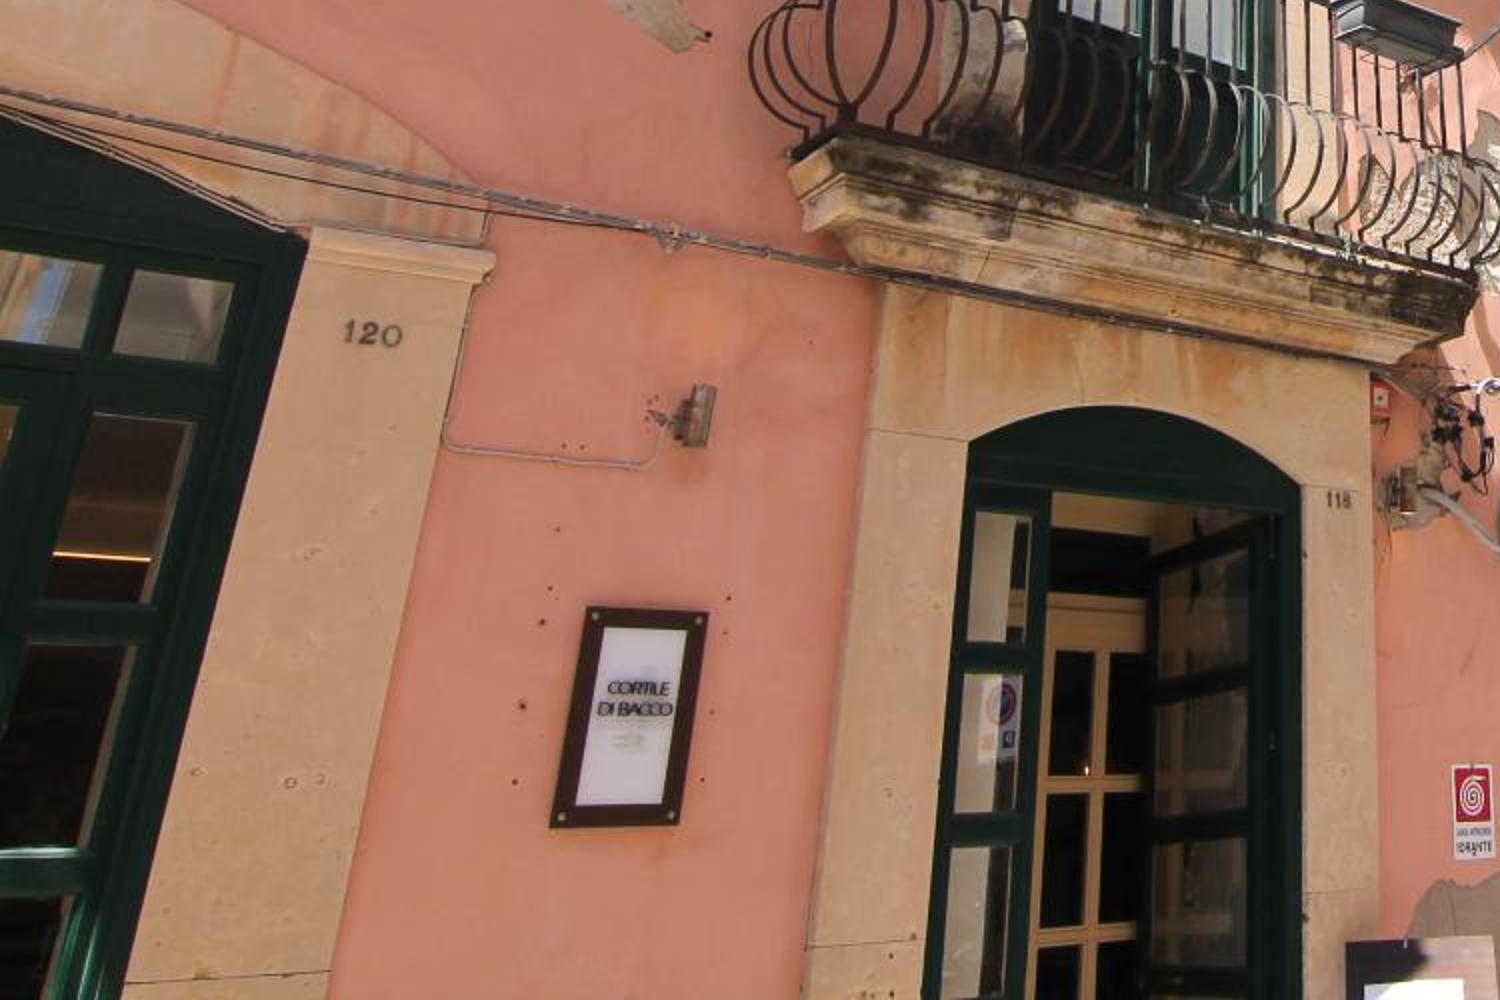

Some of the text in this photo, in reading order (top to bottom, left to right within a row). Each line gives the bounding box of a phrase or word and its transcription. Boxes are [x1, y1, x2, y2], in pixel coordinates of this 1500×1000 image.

[344, 318, 403, 348] 120
[607, 681, 671, 697] CORTILE
[598, 701, 673, 717] DI BACCO
